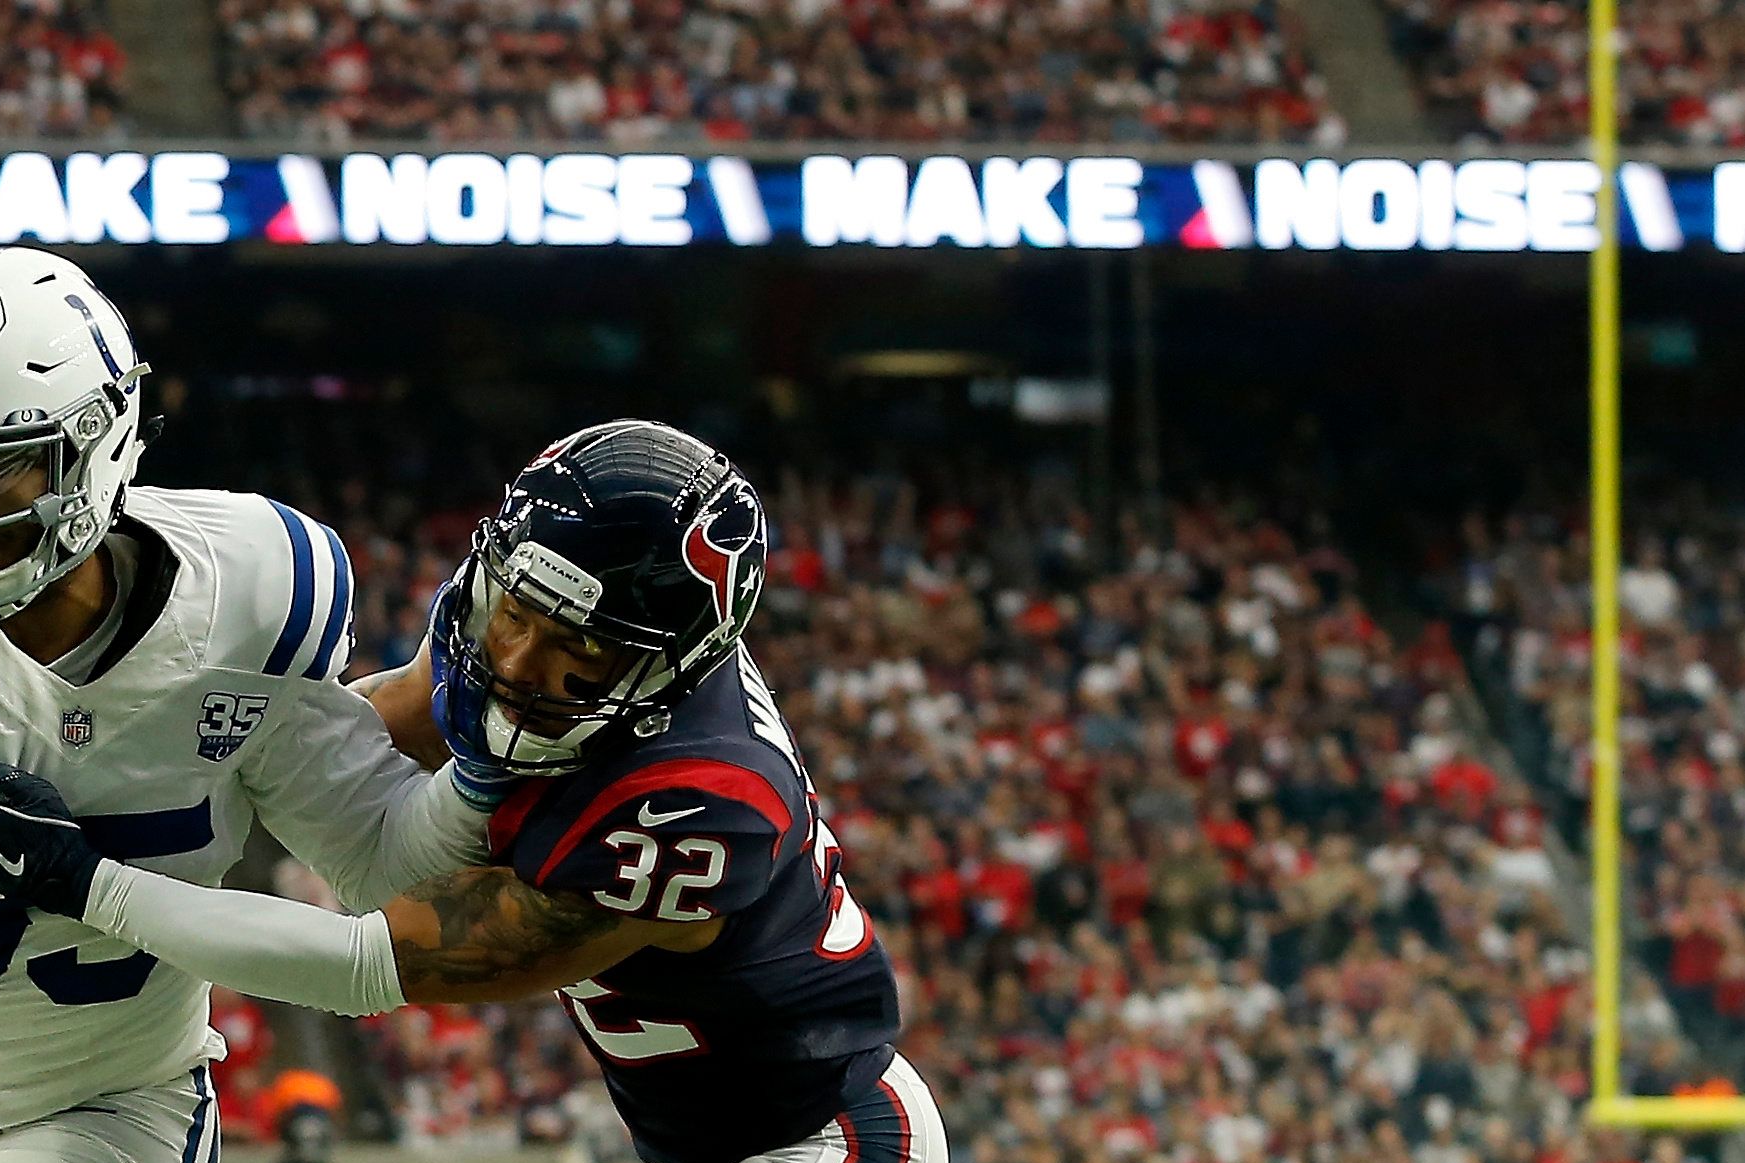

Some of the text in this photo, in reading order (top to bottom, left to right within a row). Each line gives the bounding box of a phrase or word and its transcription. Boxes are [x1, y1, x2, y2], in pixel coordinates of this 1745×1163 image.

[340, 152, 693, 245] NOISE
[800, 155, 1143, 247] MAKE
[1254, 157, 1604, 251] NOISE
[65, 724, 90, 740] NFL
[197, 691, 269, 737] 35
[590, 828, 728, 922] 32
